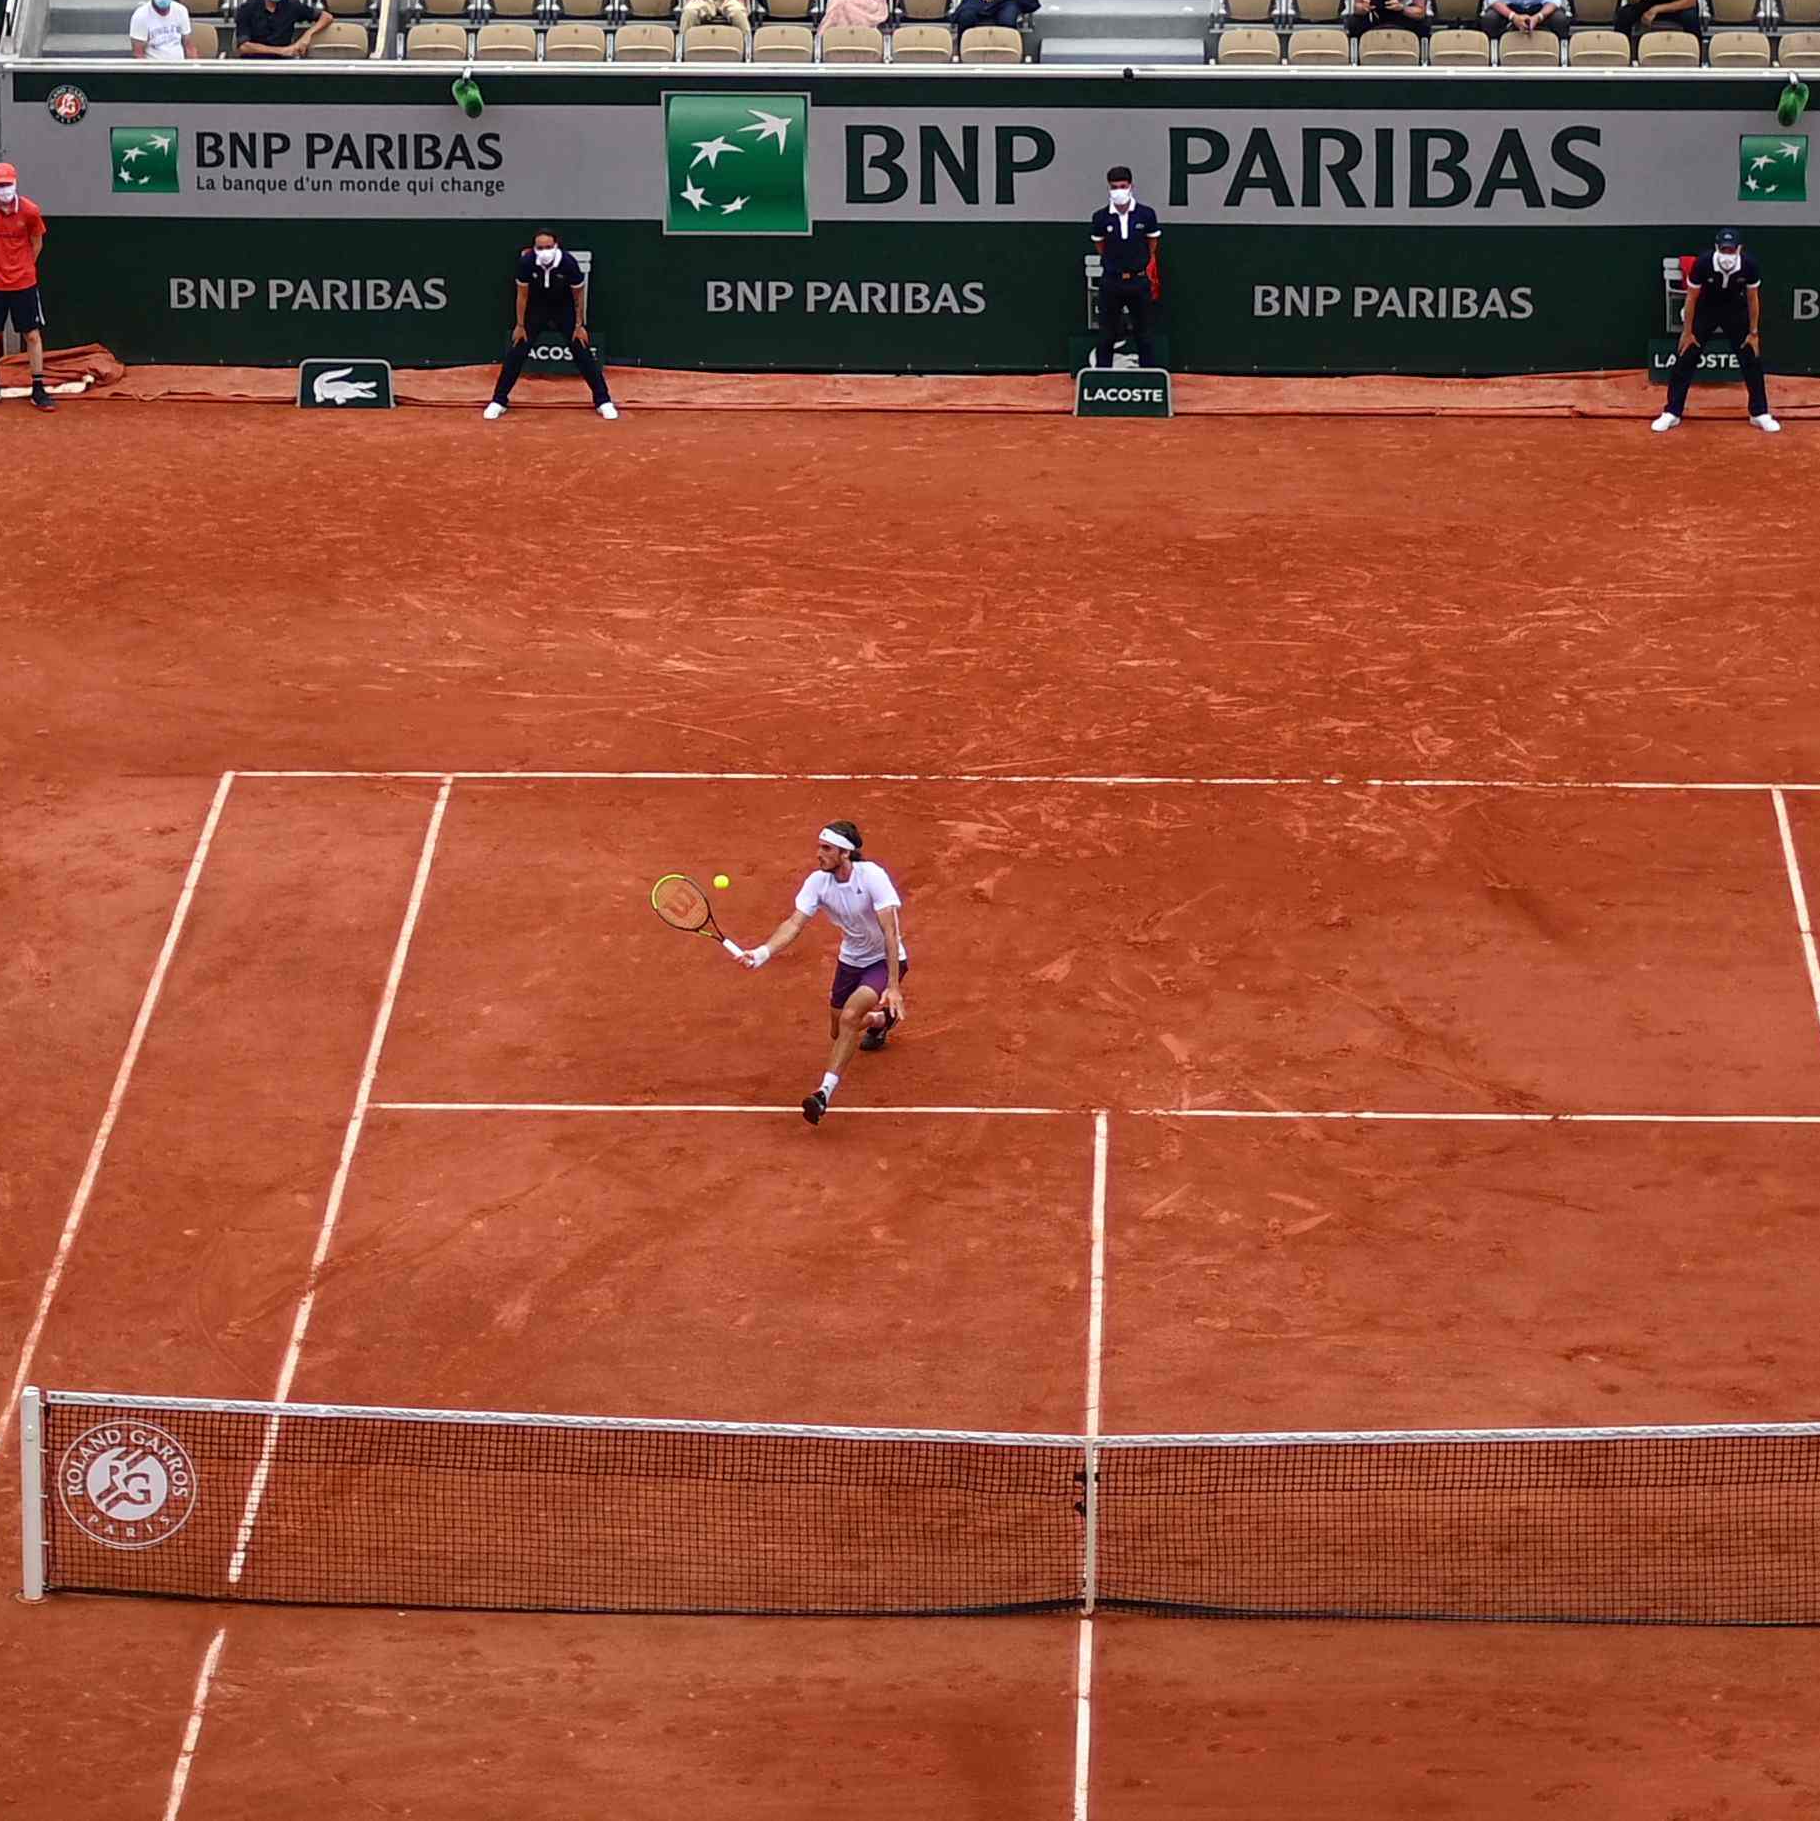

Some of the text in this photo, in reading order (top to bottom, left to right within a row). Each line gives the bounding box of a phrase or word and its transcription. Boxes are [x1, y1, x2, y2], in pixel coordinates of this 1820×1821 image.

[196, 131, 504, 171] BNP PARIBAS
[844, 124, 1606, 210] BNP PARIBAS
[196, 175, 505, 197] La banque d'un monde qui change
[169, 278, 448, 310] BNP PARIBAS
[706, 281, 986, 314] BNP PARIBAS
[1253, 284, 1534, 319] BNP PARIBAS
[1654, 353, 1740, 368] LAOSTE
[1083, 388, 1164, 402] LACOSTE
[66, 1429, 188, 1497] ROLAND GARROS
[87, 1514, 170, 1538] PARIS
